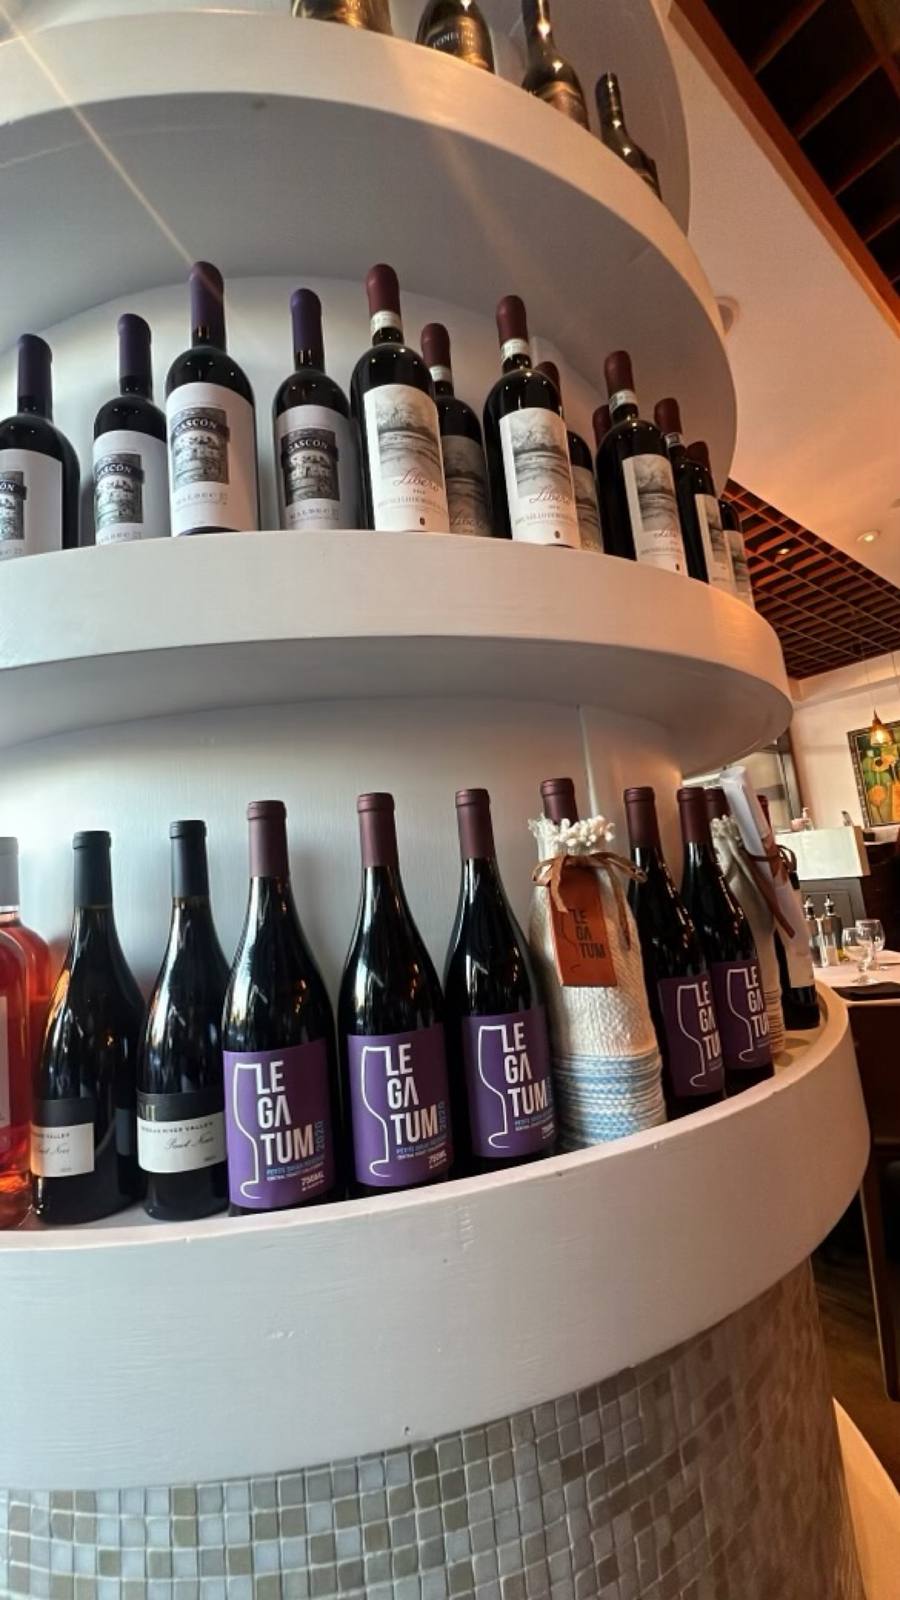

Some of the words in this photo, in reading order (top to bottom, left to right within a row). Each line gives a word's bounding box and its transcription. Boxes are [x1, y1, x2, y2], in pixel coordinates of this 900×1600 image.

[392, 466, 440, 492] Libero
[740, 966, 759, 989] LE
[502, 1021, 527, 1053] LE
[385, 1043, 413, 1076] LE
[504, 1052, 533, 1084] GA
[256, 1060, 286, 1095] LE
[387, 1076, 420, 1110] GA
[257, 1095, 292, 1129] GA
[507, 1079, 549, 1118] TUM
[390, 1104, 439, 1146] TUM
[260, 1123, 315, 1166] TUM
